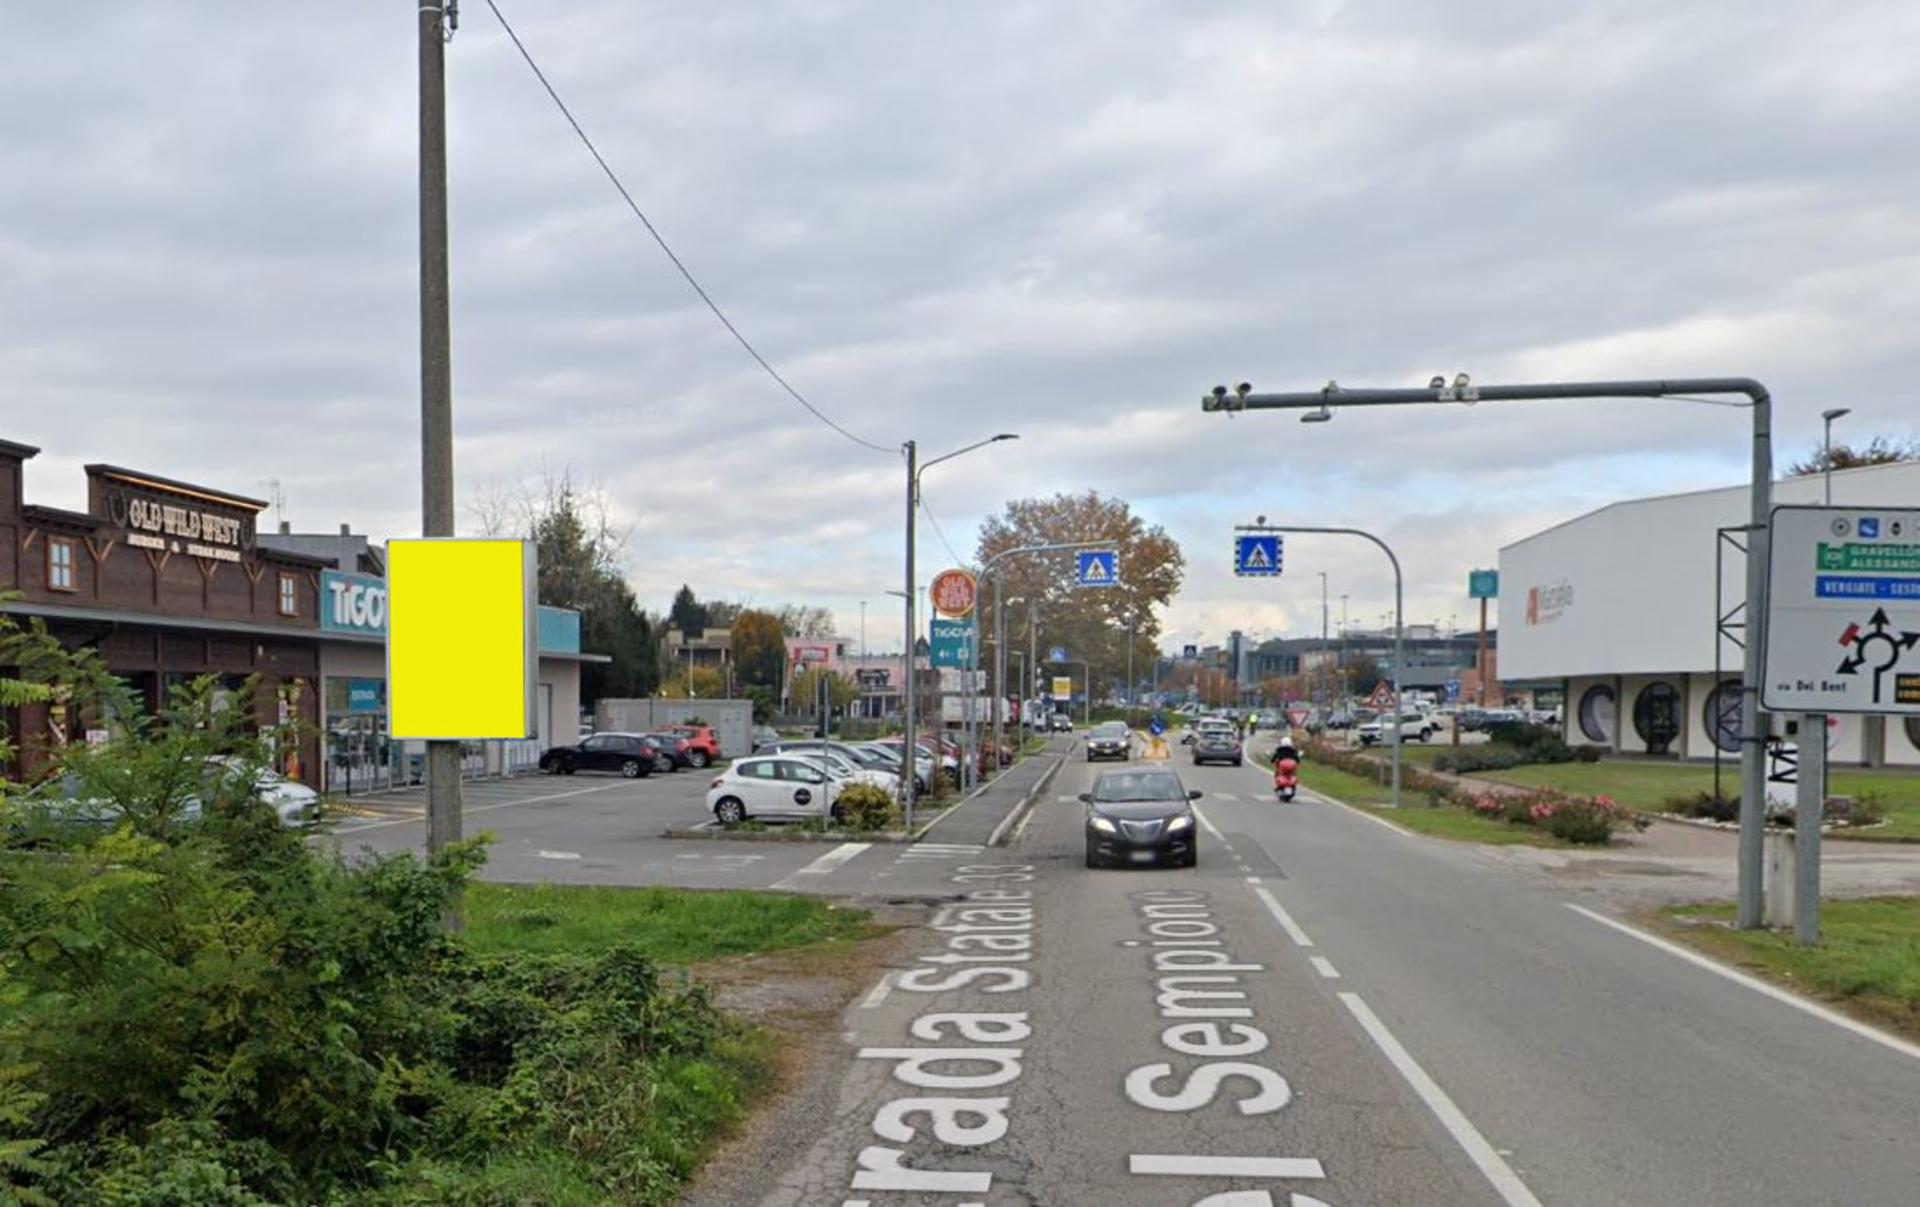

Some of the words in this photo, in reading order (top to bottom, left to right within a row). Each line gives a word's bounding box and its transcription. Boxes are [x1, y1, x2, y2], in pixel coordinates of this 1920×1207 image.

[128, 498, 163, 531] OLD
[162, 505, 200, 538] WILD
[201, 514, 240, 545] WEST
